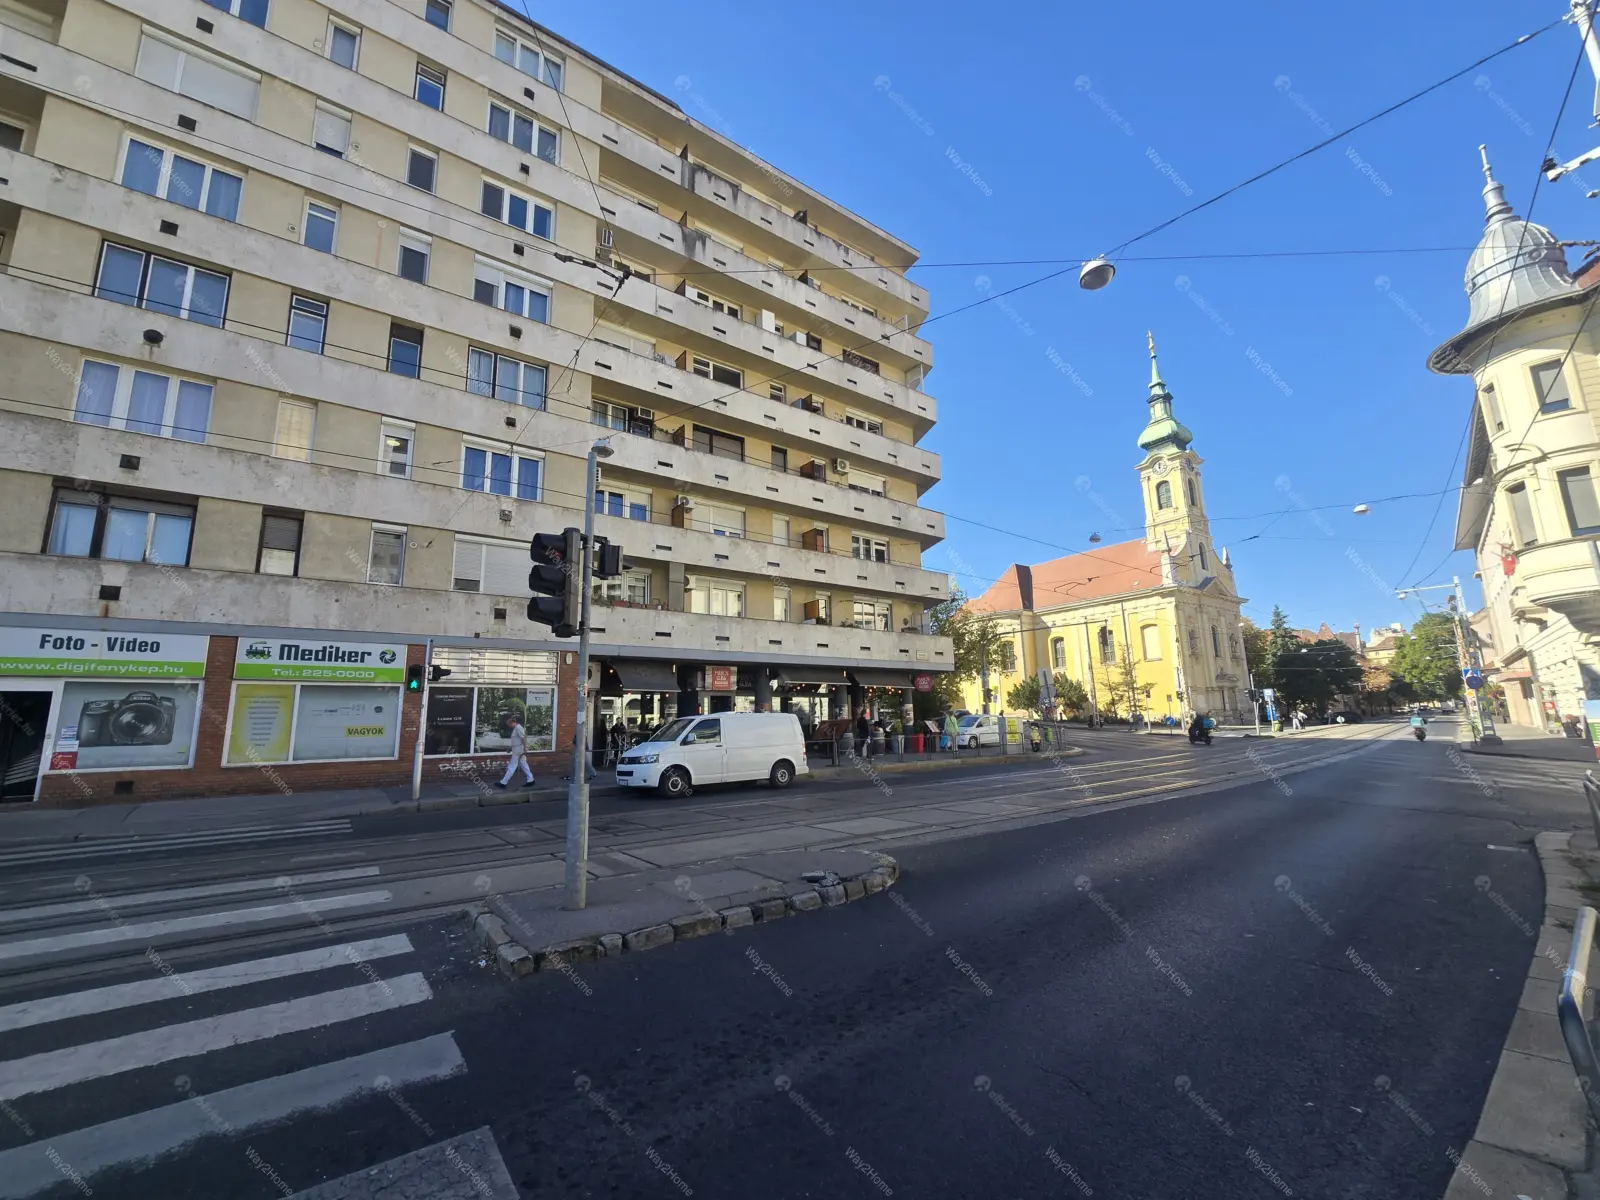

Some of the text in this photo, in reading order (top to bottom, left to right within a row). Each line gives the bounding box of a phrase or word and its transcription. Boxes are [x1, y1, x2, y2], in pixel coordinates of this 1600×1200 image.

[39, 633, 86, 651] Foto
[106, 636, 161, 653] Video
[278, 644, 372, 663] Mediker
[0, 662, 184, 674] www.digifenykep.hu
[272, 668, 375, 678] Tel.: 225-0000
[347, 727, 384, 736] VAGYOK
